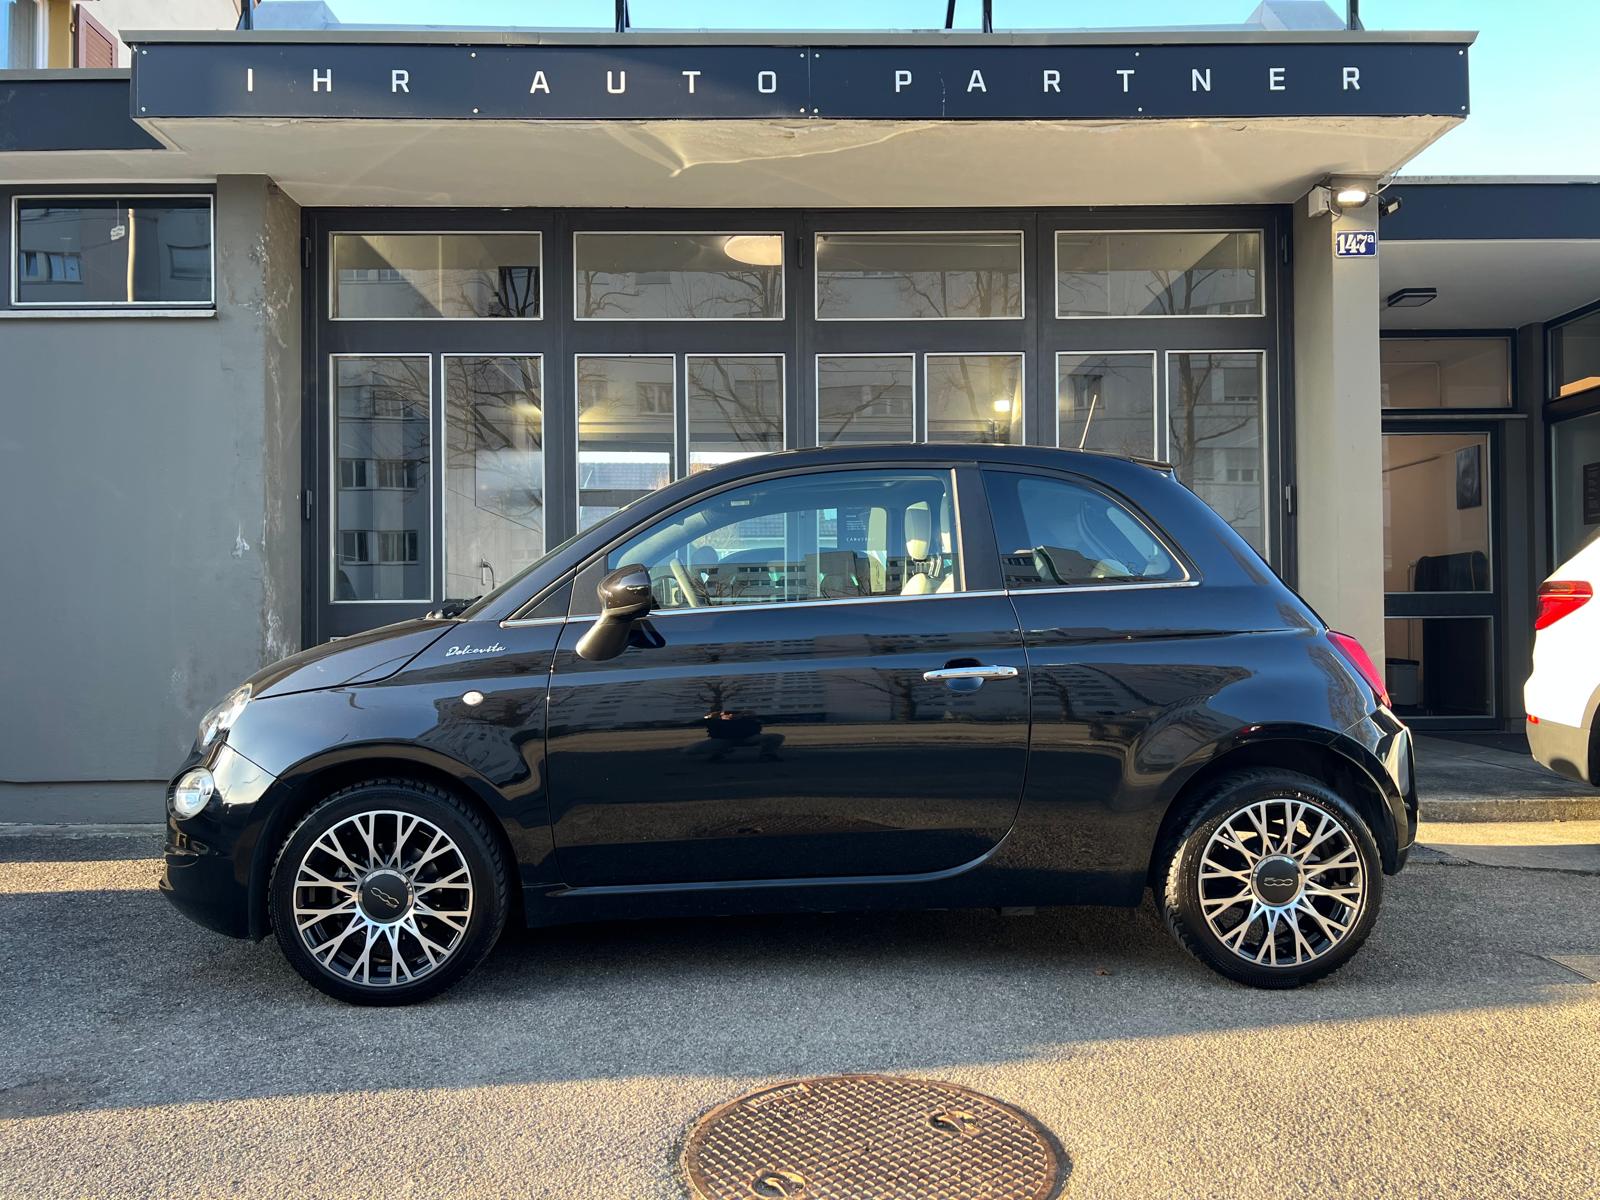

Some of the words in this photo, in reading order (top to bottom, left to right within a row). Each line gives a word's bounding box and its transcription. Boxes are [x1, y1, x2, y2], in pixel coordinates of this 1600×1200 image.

[246, 68, 411, 94] IHR
[528, 69, 778, 95] AUTO
[894, 67, 1362, 94] PARTNER
[1337, 233, 1375, 254] 147a
[445, 642, 507, 657] Dolcevita
